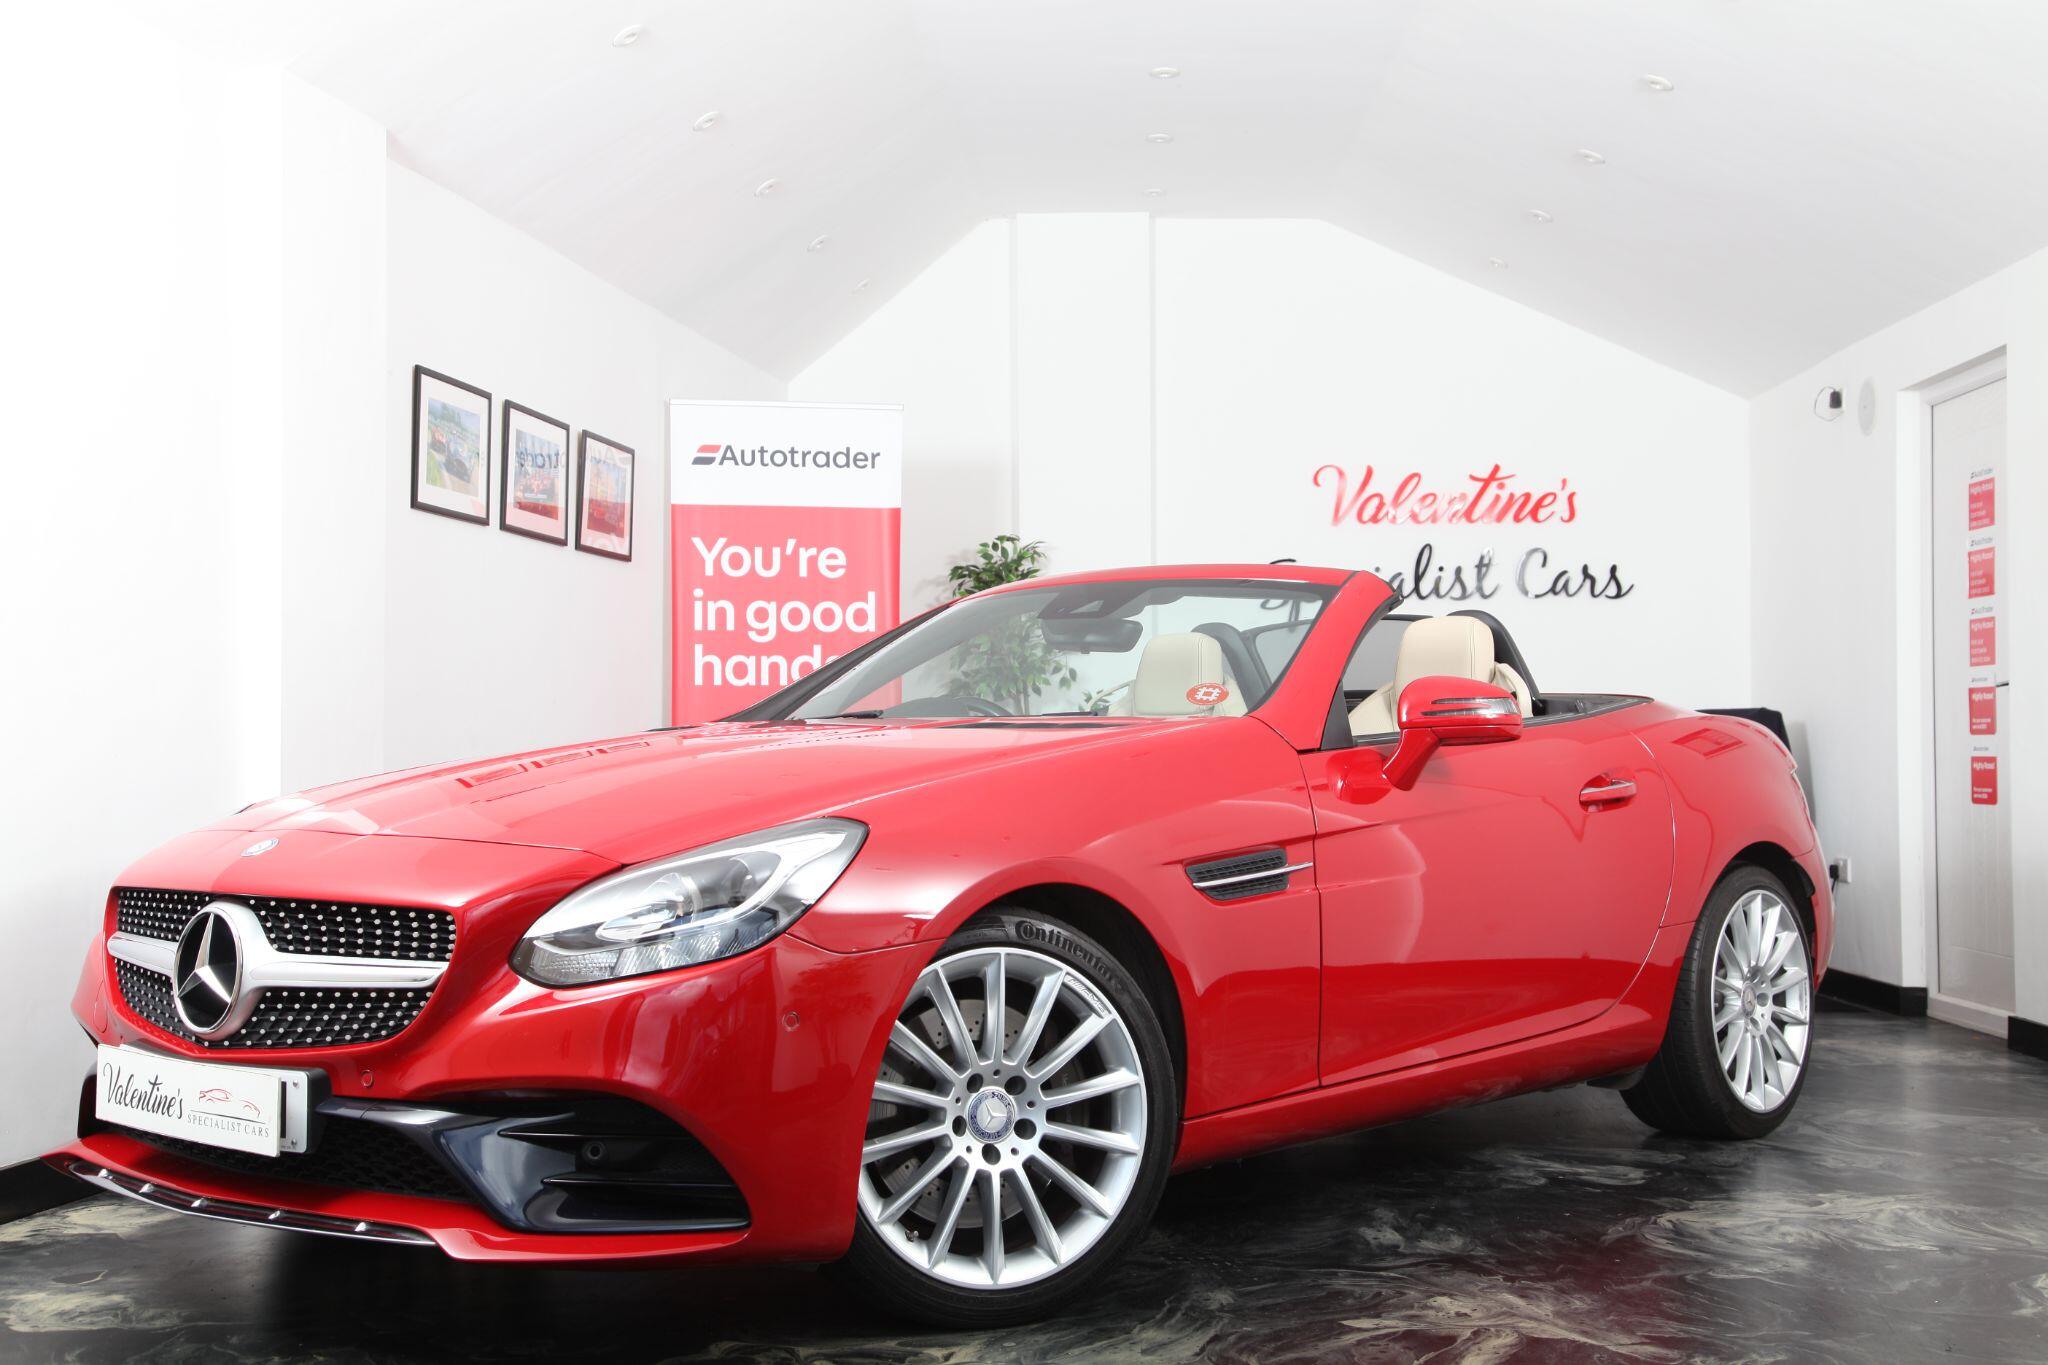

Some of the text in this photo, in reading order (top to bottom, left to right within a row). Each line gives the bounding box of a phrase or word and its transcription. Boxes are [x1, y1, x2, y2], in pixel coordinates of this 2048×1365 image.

[718, 444, 881, 469] Autotrader
[1312, 463, 1578, 528] Valentine's
[690, 536, 848, 579] You're
[1516, 546, 1636, 601] Cars
[692, 588, 877, 643] in good
[693, 644, 839, 687] hand
[103, 1062, 184, 1120] Valentine's
[187, 1113, 270, 1138] SPECIALIST CARS
